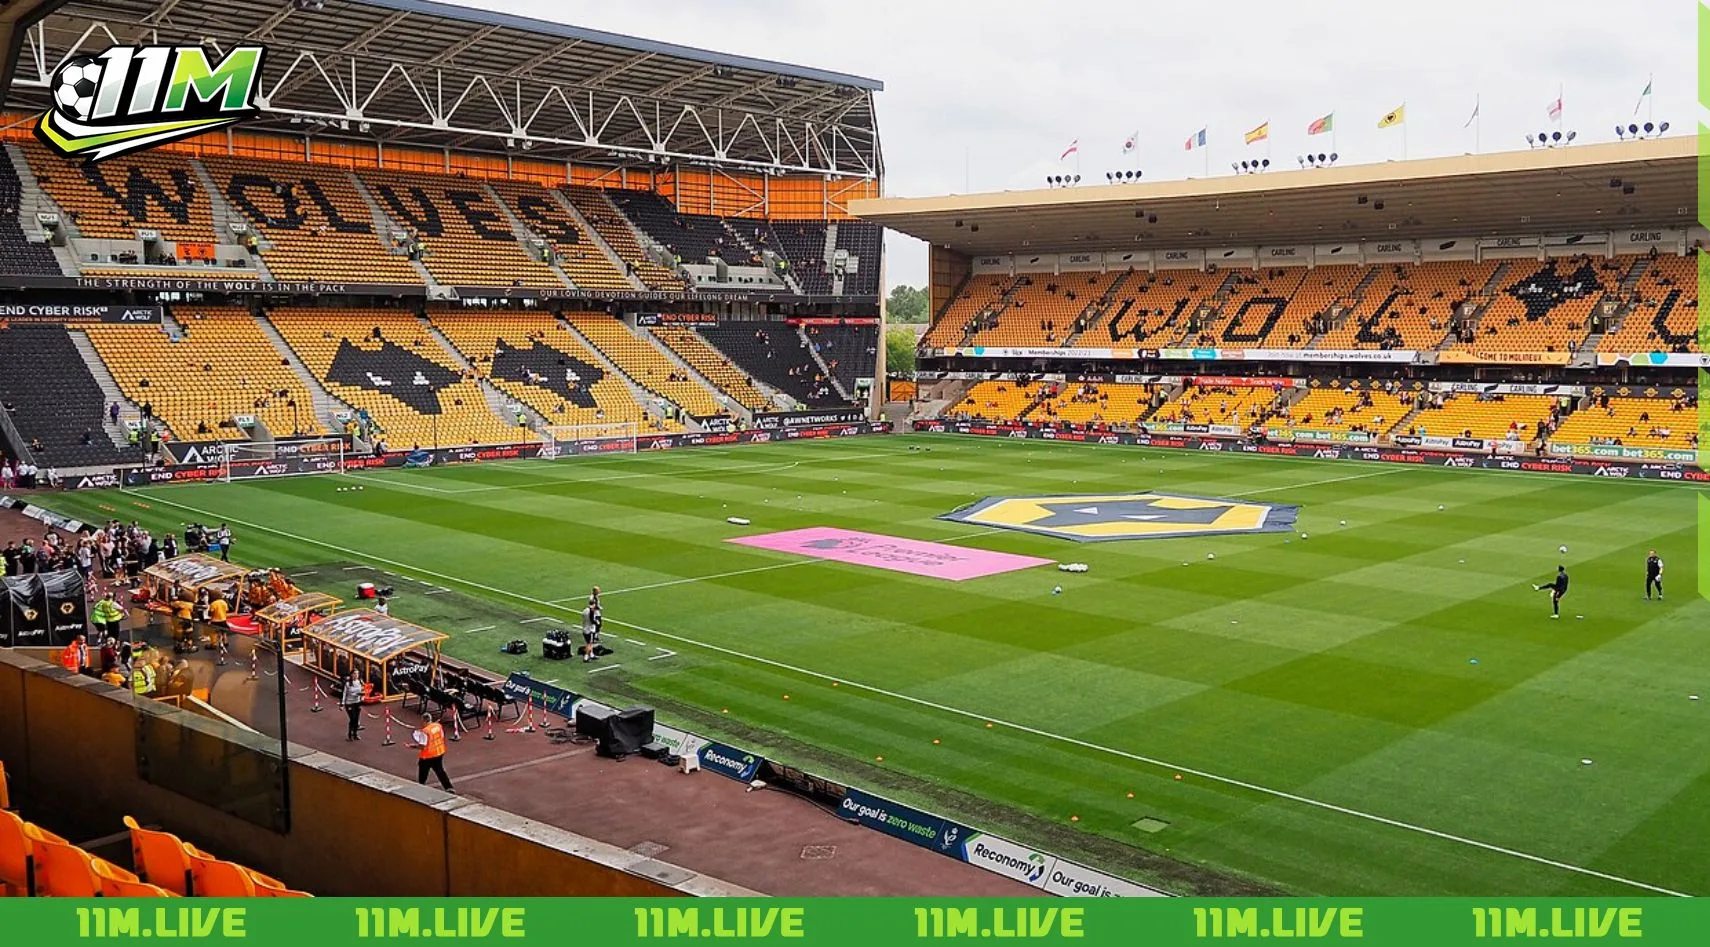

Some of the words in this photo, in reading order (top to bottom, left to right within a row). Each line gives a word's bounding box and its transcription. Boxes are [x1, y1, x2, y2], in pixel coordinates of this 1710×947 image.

[1630, 232, 1661, 242] CARLING
[76, 279, 98, 288] THE
[106, 280, 170, 288] STRENGTH
[176, 281, 190, 289] OF
[224, 282, 257, 290] WOLF
[320, 284, 346, 292] PACK
[0, 306, 25, 315] END
[29, 306, 70, 315] CYBER
[73, 306, 101, 316] RISK
[1304, 352, 1392, 360] memberships.wolves.co.uk
[783, 414, 838, 426] @AWNETWORKS
[1316, 431, 1370, 442] bet365.com
[1455, 440, 1481, 448] AstroPay
[477, 451, 501, 459] CYBER
[1553, 444, 1619, 456] bet365.com
[1623, 448, 1693, 461] bet365.com
[366, 456, 385, 465] RISK
[151, 472, 172, 480] END
[174, 470, 206, 478] CYBER
[393, 665, 429, 676] AstroPay
[704, 749, 747, 774] Reconomy
[843, 798, 860, 811] Our
[858, 806, 879, 821] goal
[878, 811, 887, 822] is
[887, 815, 907, 828] zero
[908, 822, 936, 838] waste
[974, 843, 1036, 876] Reconomy
[1052, 871, 1074, 887] Our
[1073, 881, 1100, 897] goal
[1101, 887, 1112, 897] is
